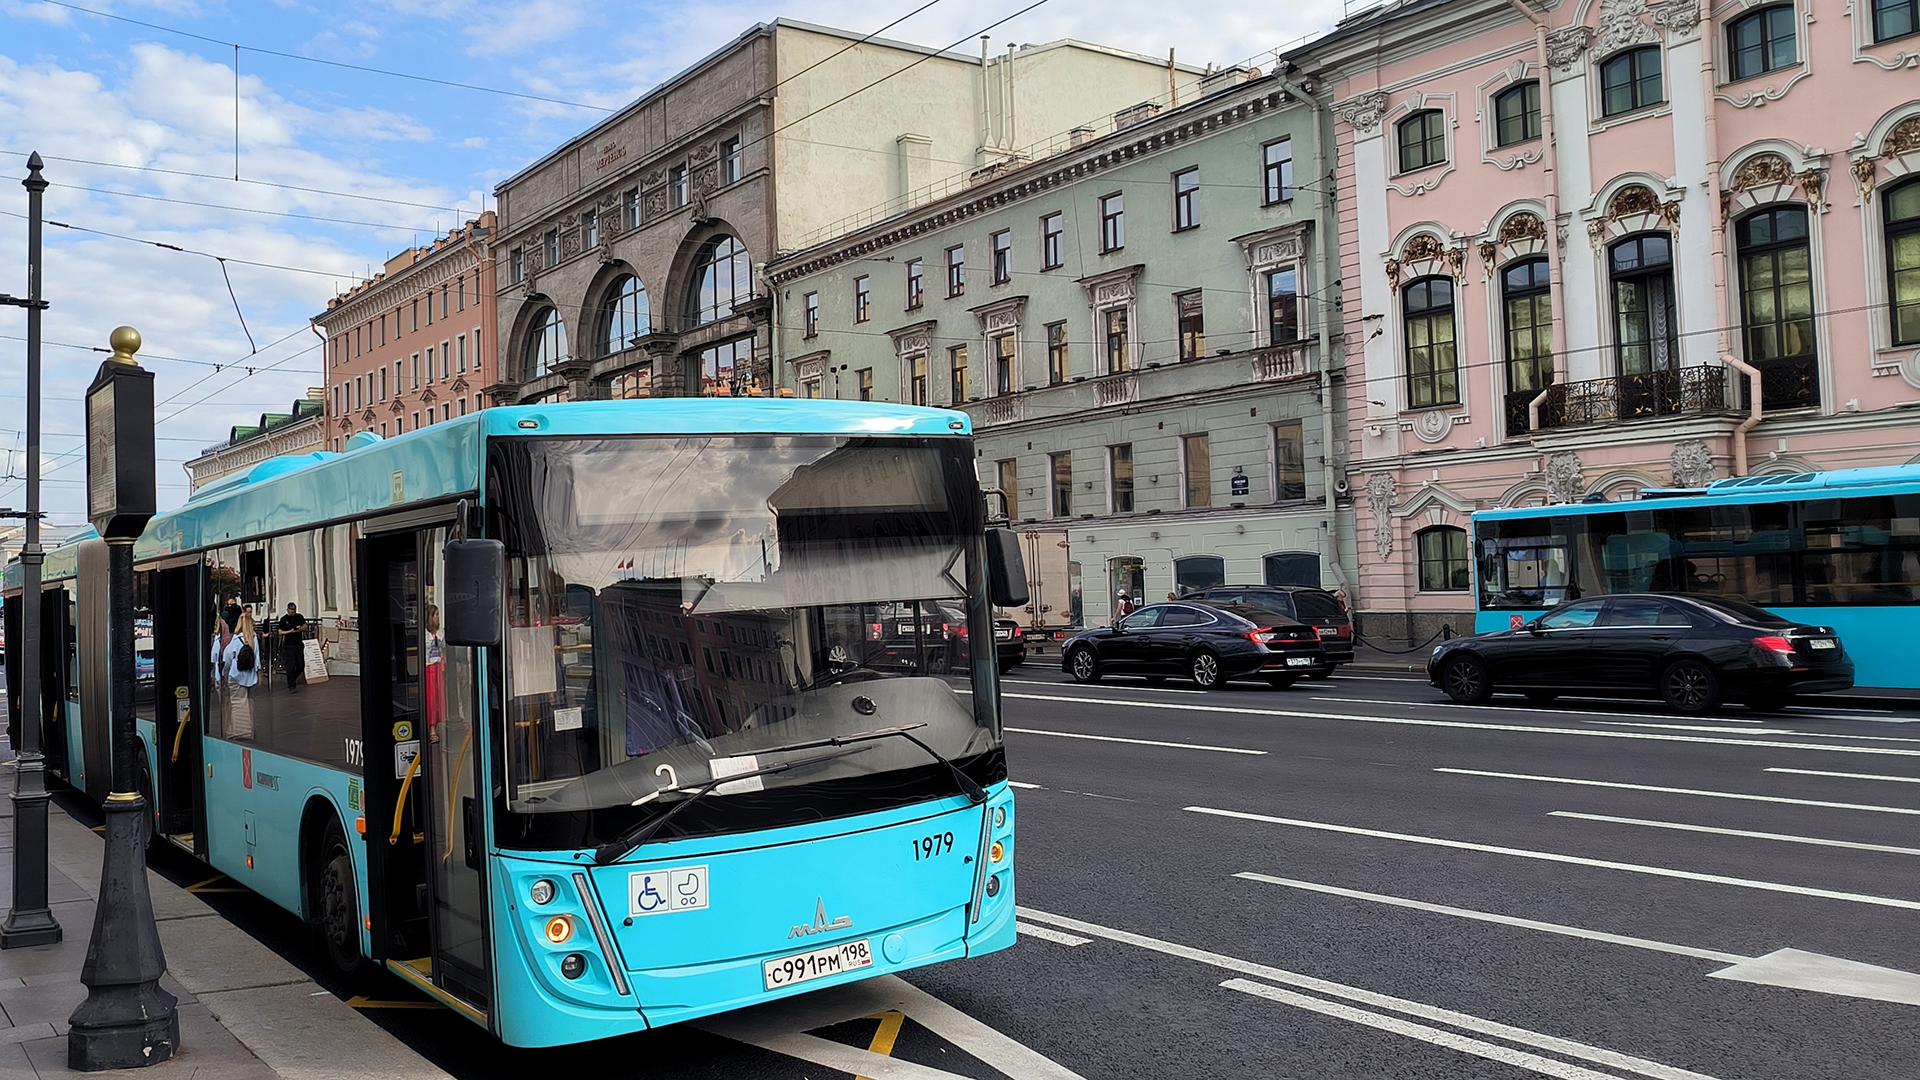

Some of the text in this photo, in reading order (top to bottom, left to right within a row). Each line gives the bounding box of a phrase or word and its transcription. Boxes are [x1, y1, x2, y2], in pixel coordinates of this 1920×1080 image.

[912, 831, 954, 861] 1979
[842, 943, 866, 961] 198
[848, 960, 862, 968] RUS
